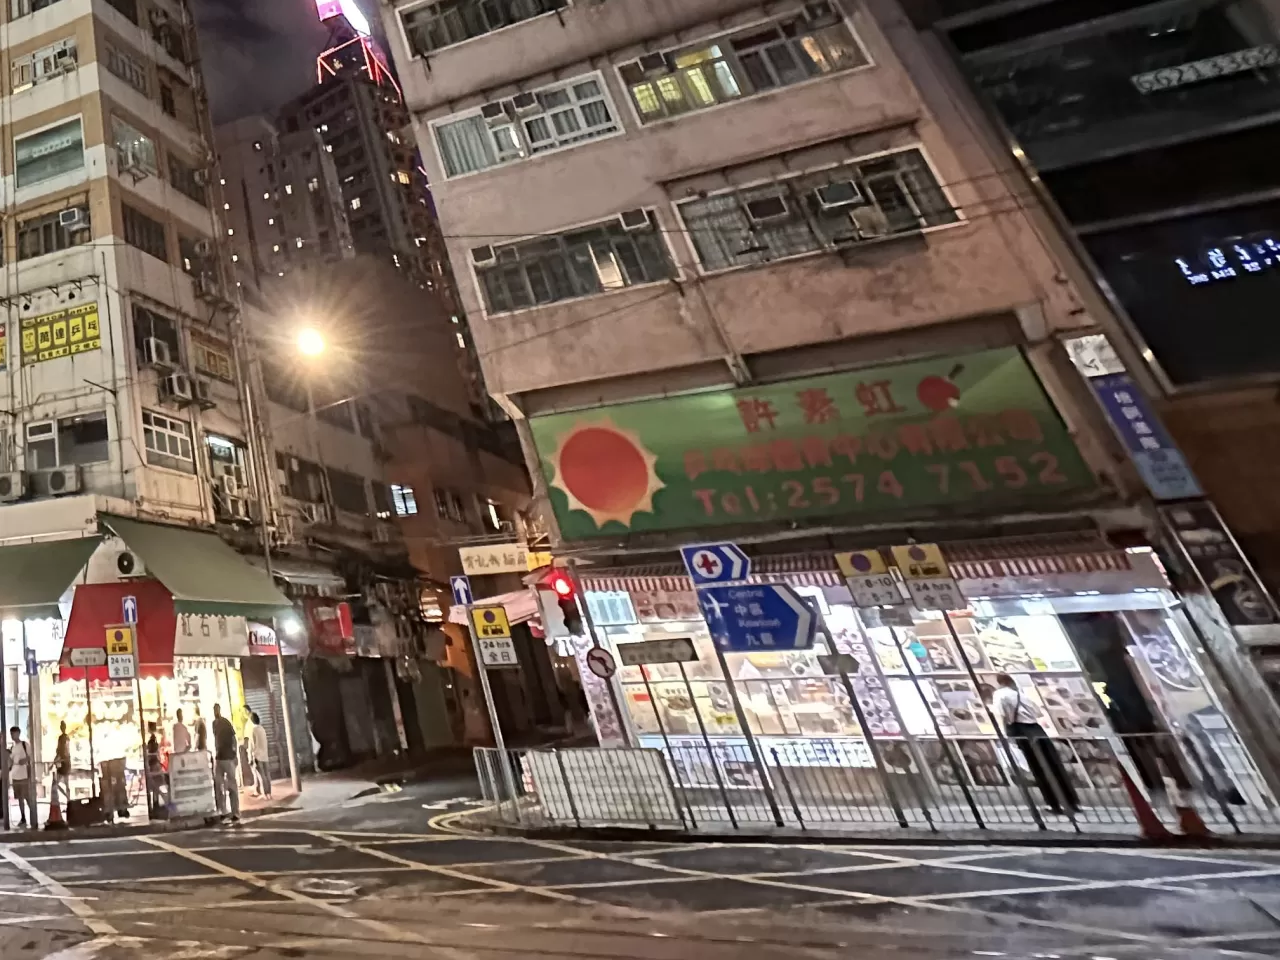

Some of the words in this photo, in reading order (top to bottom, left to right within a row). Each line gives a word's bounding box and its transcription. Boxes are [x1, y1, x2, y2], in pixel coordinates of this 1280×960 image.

[926, 451, 1068, 494] 7152
[482, 640, 495, 650] 24
[496, 639, 511, 649] hrs
[110, 656, 119, 665] 24
[120, 656, 131, 665] hrs
[488, 651, 512, 662] 全日
[112, 666, 130, 676] 全日
